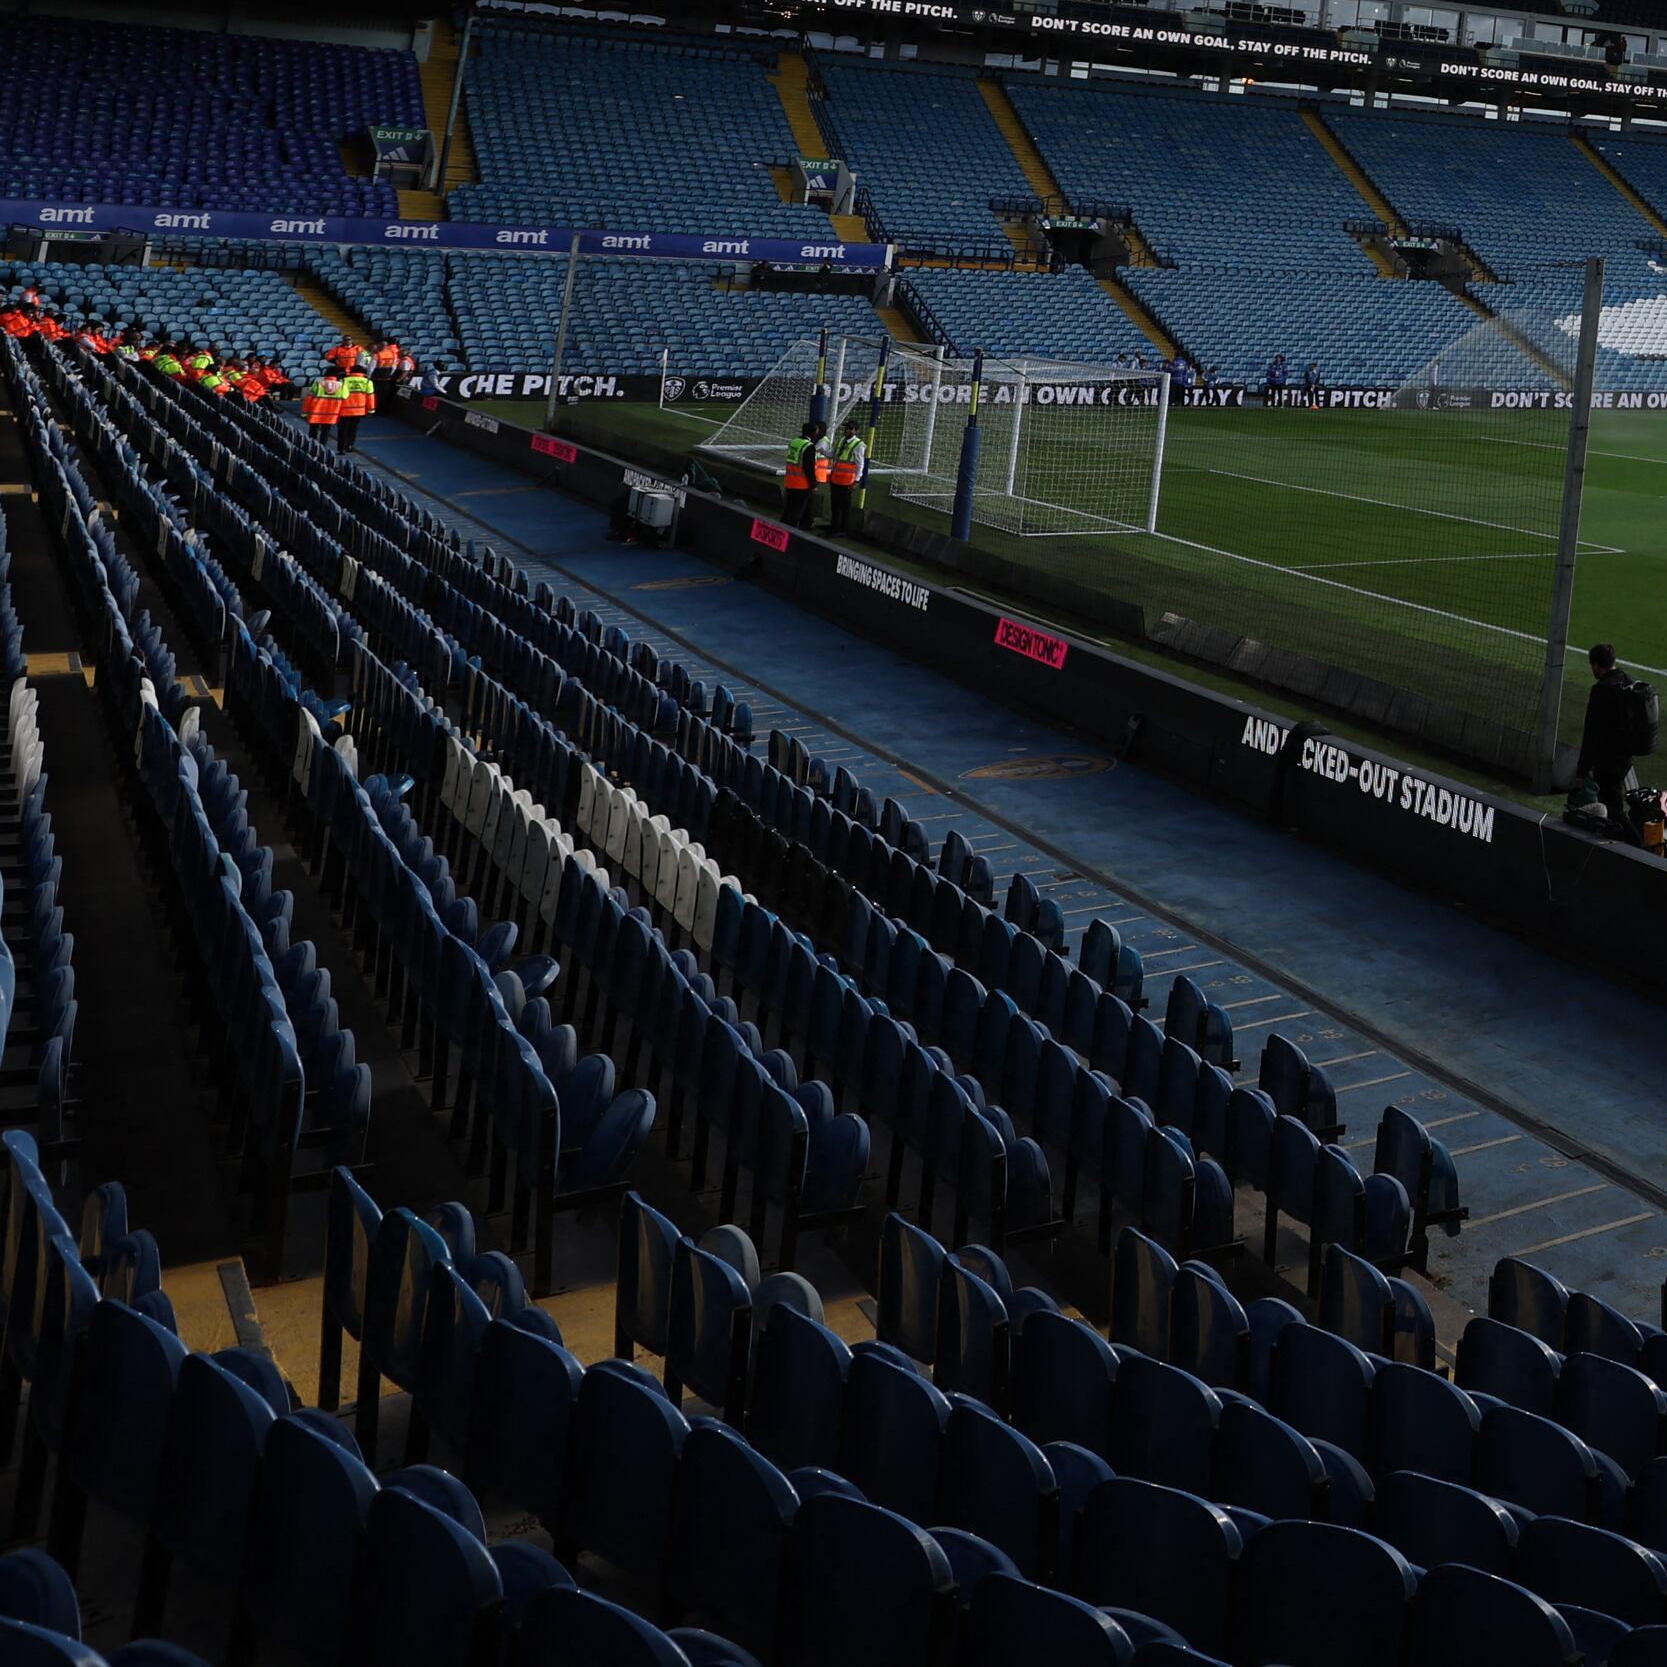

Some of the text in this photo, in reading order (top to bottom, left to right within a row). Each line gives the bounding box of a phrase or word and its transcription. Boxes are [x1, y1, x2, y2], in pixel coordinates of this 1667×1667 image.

[871, 0, 901, 12] THE
[905, 3, 957, 18] PITCH.
[1032, 17, 1371, 64] DON'T SCORE AN OWN GOAL, STAY OFF THE PITCH.
[1441, 64, 1478, 76] DON'T
[1481, 68, 1519, 81] SCORE
[1521, 73, 1537, 83] AN
[1541, 75, 1567, 86] OWN
[1570, 79, 1602, 91] GOAL,
[1605, 83, 1631, 93] STAY
[1634, 86, 1654, 95] OFF
[376, 130, 403, 140] EXIT
[801, 160, 822, 169] EXIT
[40, 207, 845, 258] amt amt amt amt amt amt amt amt
[522, 375, 624, 400] PITCH.
[710, 381, 743, 389] Premier
[710, 390, 742, 398] League
[1036, 382, 1094, 404] OWN
[1330, 390, 1399, 409] PITCH.
[1491, 392, 1550, 407] DON'T
[1554, 392, 1613, 408] SCRE
[1617, 393, 1642, 407] AN
[836, 554, 930, 611] BRINGING SPACES TO LIFE
[1241, 716, 1495, 843] AND CKED-OUT STADIUM
